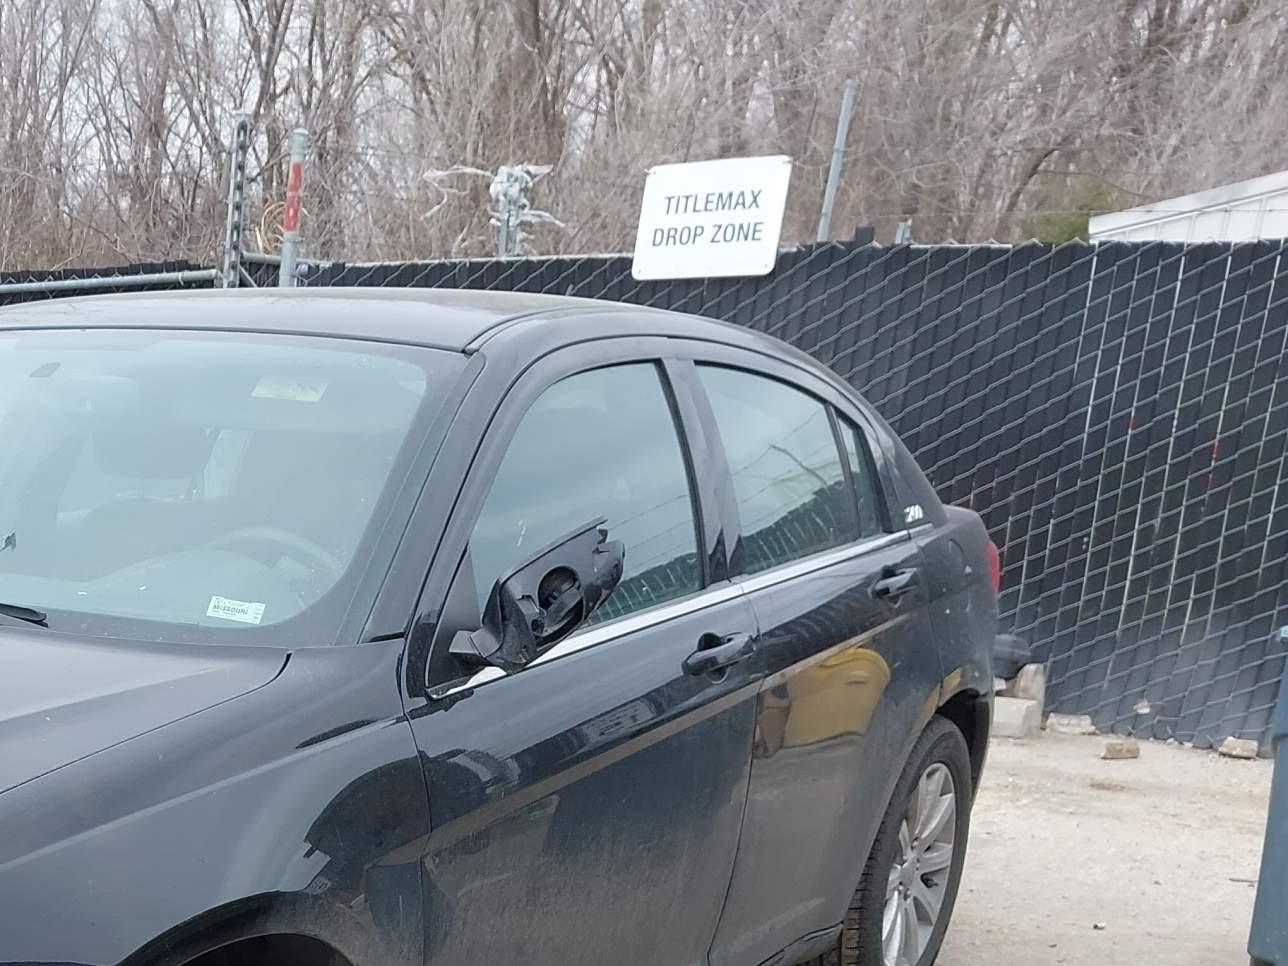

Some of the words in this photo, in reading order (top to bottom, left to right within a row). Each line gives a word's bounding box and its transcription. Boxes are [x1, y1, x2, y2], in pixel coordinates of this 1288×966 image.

[664, 189, 762, 215] TITLEMAX
[652, 225, 705, 247] DROP
[709, 221, 764, 243] ZONE
